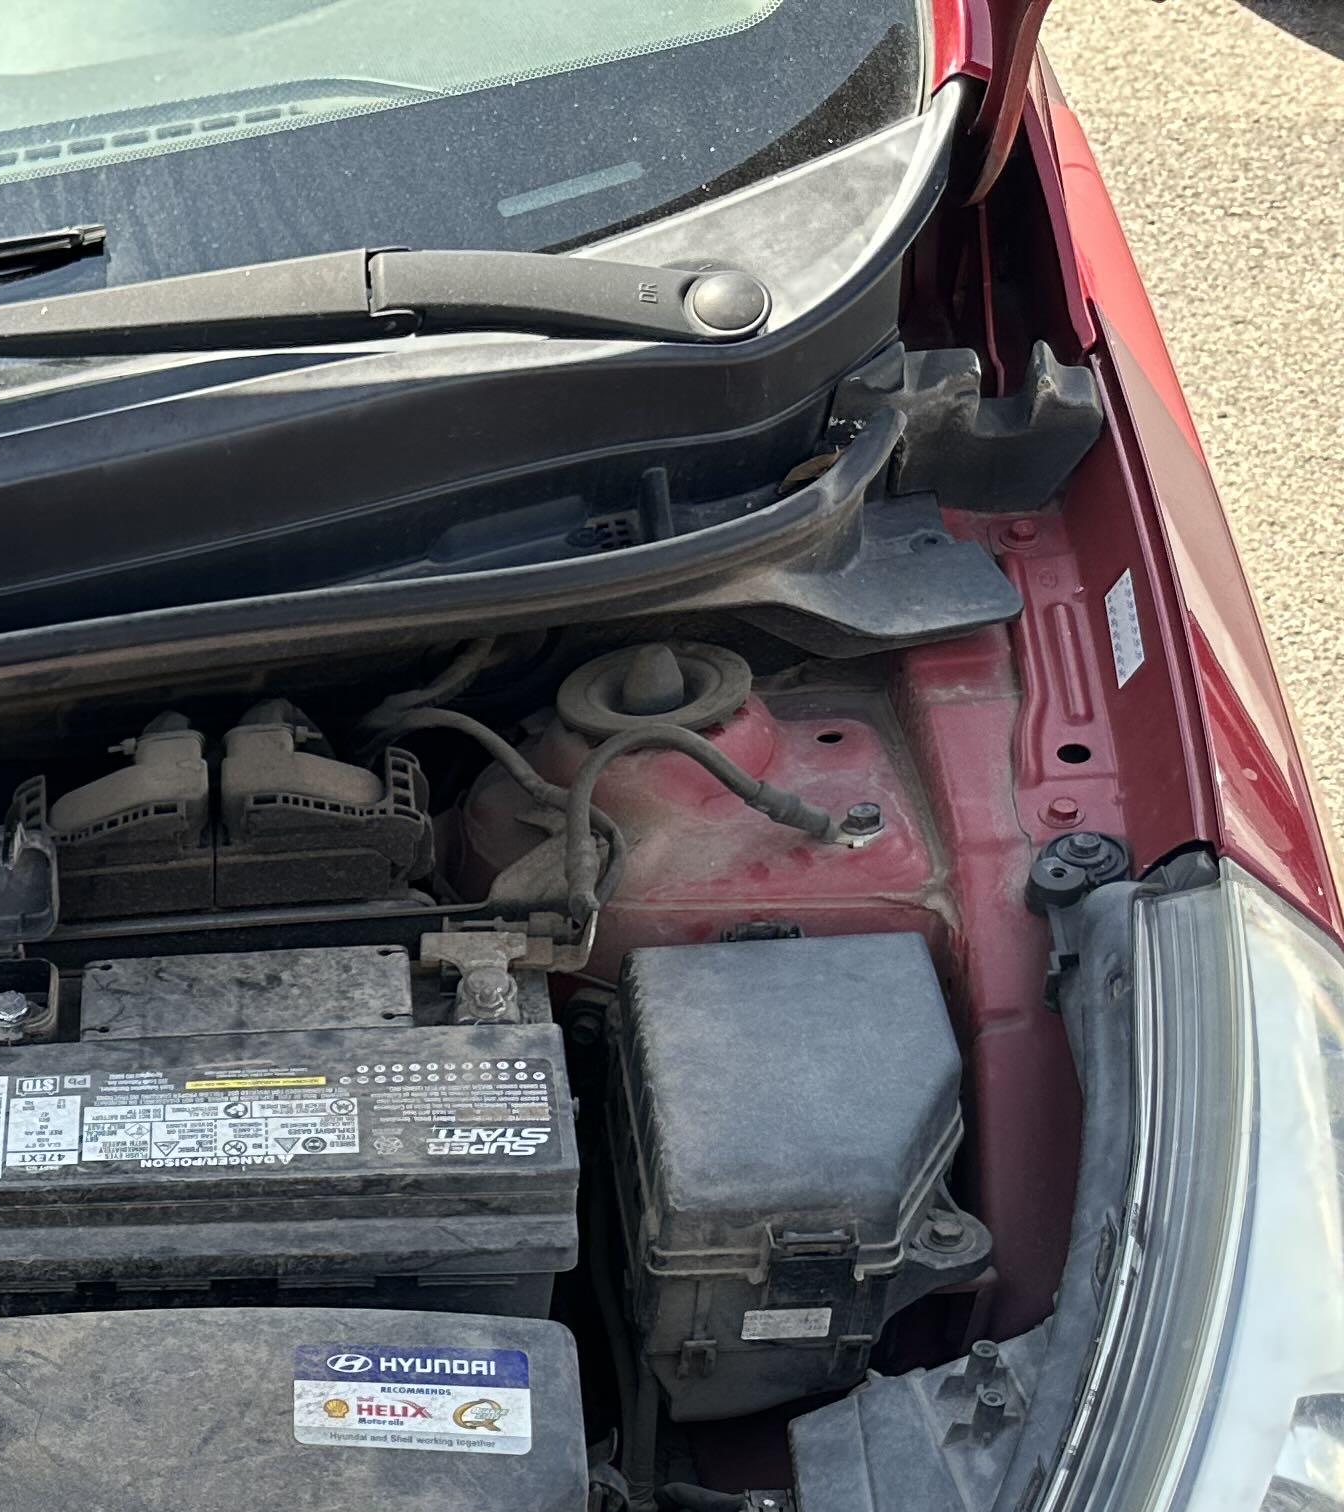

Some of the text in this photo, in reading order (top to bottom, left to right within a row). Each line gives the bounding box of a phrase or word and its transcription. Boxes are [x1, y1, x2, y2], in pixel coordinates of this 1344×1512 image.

[22, 1079, 54, 1092] STD
[426, 1127, 552, 1143] START
[427, 1141, 536, 1156] SUPER
[19, 1154, 65, 1162] 47EXT
[140, 1155, 275, 1168] DANGER/POISON
[380, 1358, 496, 1376] HYUNDAI
[380, 1386, 452, 1395] RECOMMENDS
[356, 1400, 433, 1419] HELIX
[329, 1432, 368, 1442] Hyundai
[417, 1437, 453, 1447] working
